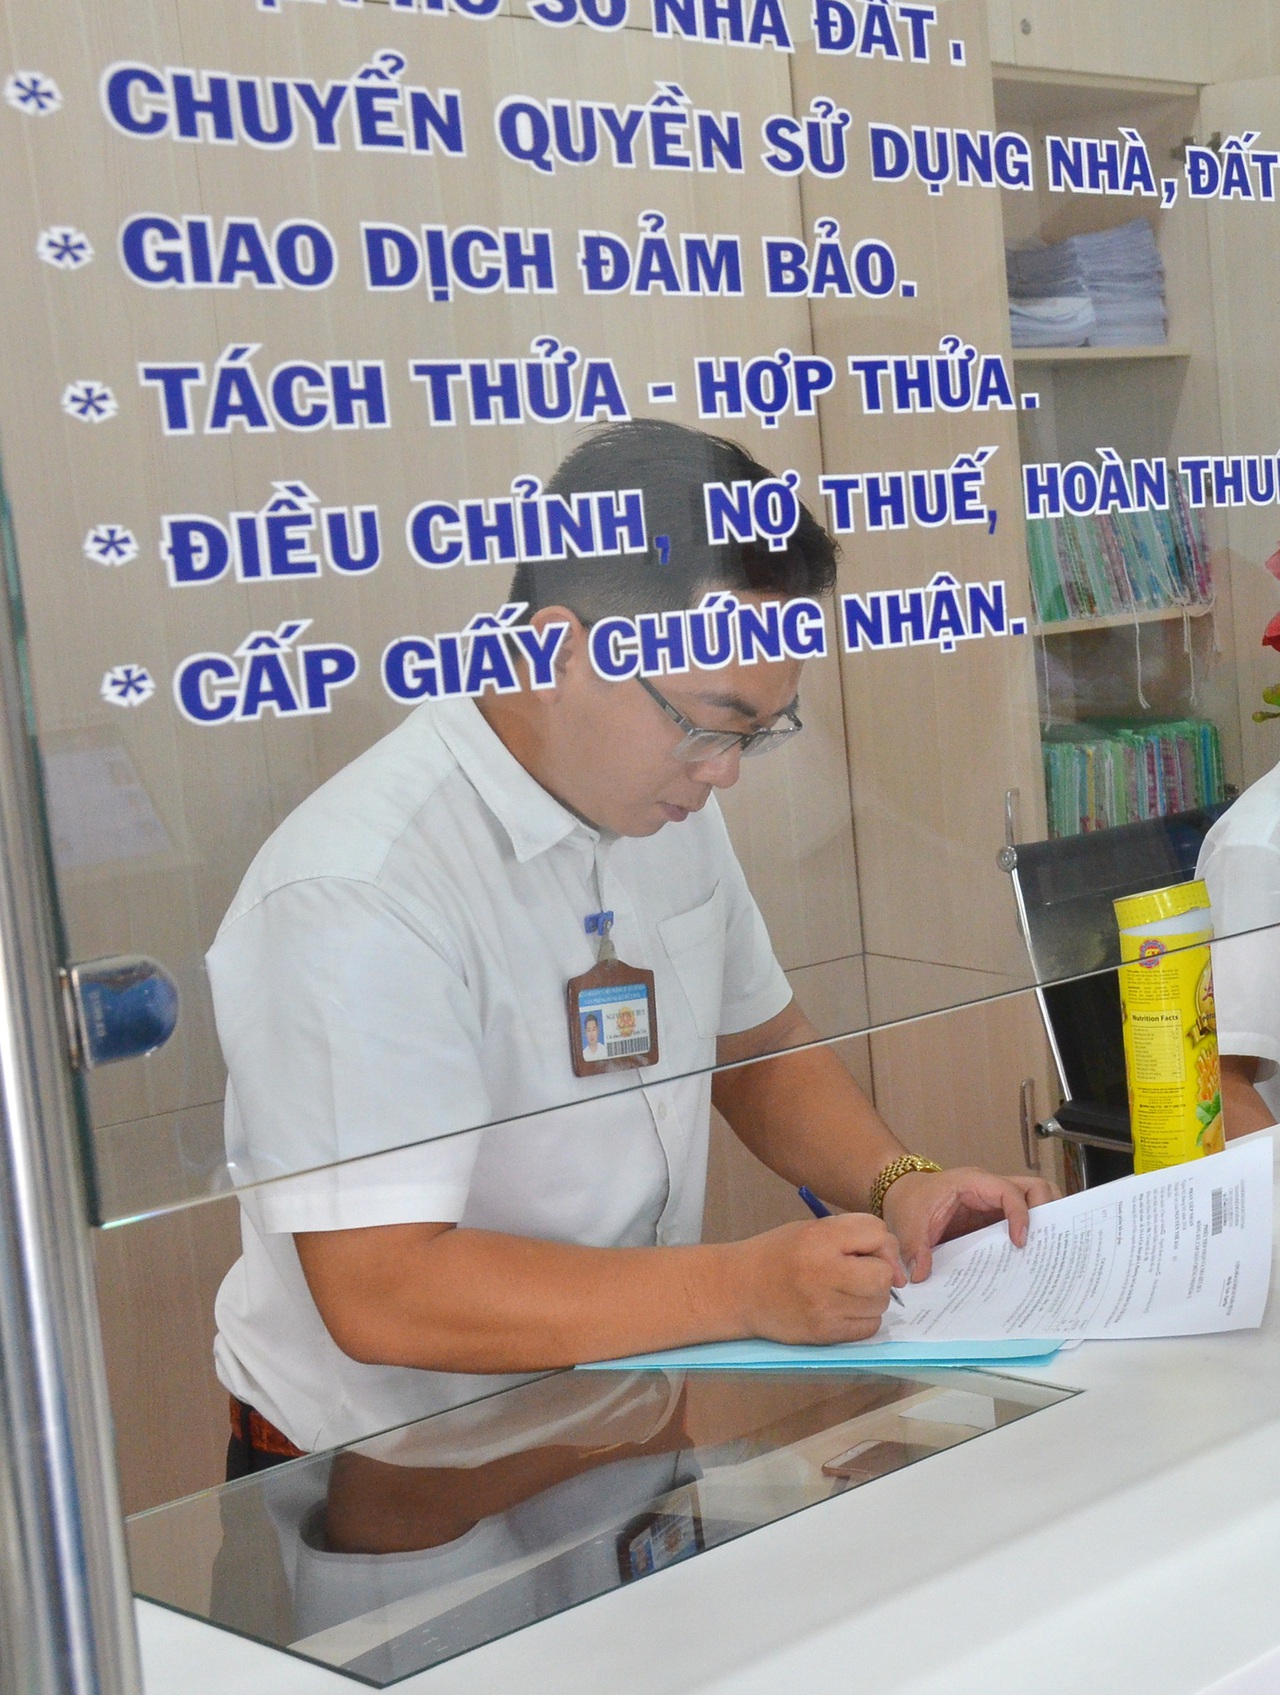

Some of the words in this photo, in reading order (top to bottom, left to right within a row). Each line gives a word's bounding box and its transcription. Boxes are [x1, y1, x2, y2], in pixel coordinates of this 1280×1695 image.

[104, 51, 466, 156] CHUYỂN
[496, 82, 746, 175] QUYỀN
[762, 98, 854, 177] SỬ
[868, 125, 1033, 196] DỤNG
[119, 215, 337, 290] GIAO
[362, 225, 557, 304] DỊCH
[579, 211, 745, 296] ĐẢM
[764, 218, 918, 300] BẢO.
[141, 344, 390, 433] TÁCH
[411, 336, 630, 425] THỬA
[695, 349, 837, 429] HỢP
[849, 334, 1040, 414] THỬA.
[164, 482, 383, 586] ĐIỀU
[409, 476, 674, 568] CHỈNH,
[705, 470, 801, 551] NỢ
[819, 448, 1000, 537] THUẾ,
[1023, 448, 1170, 518] HOÀN
[176, 621, 360, 725] CẤP
[382, 605, 566, 702] GIẤY
[590, 593, 828, 680] CHỨNG
[841, 572, 1028, 654] NHẬN.
[1132, 1014, 1160, 1022] Nutrition
[1161, 1014, 1179, 1022] Facts
